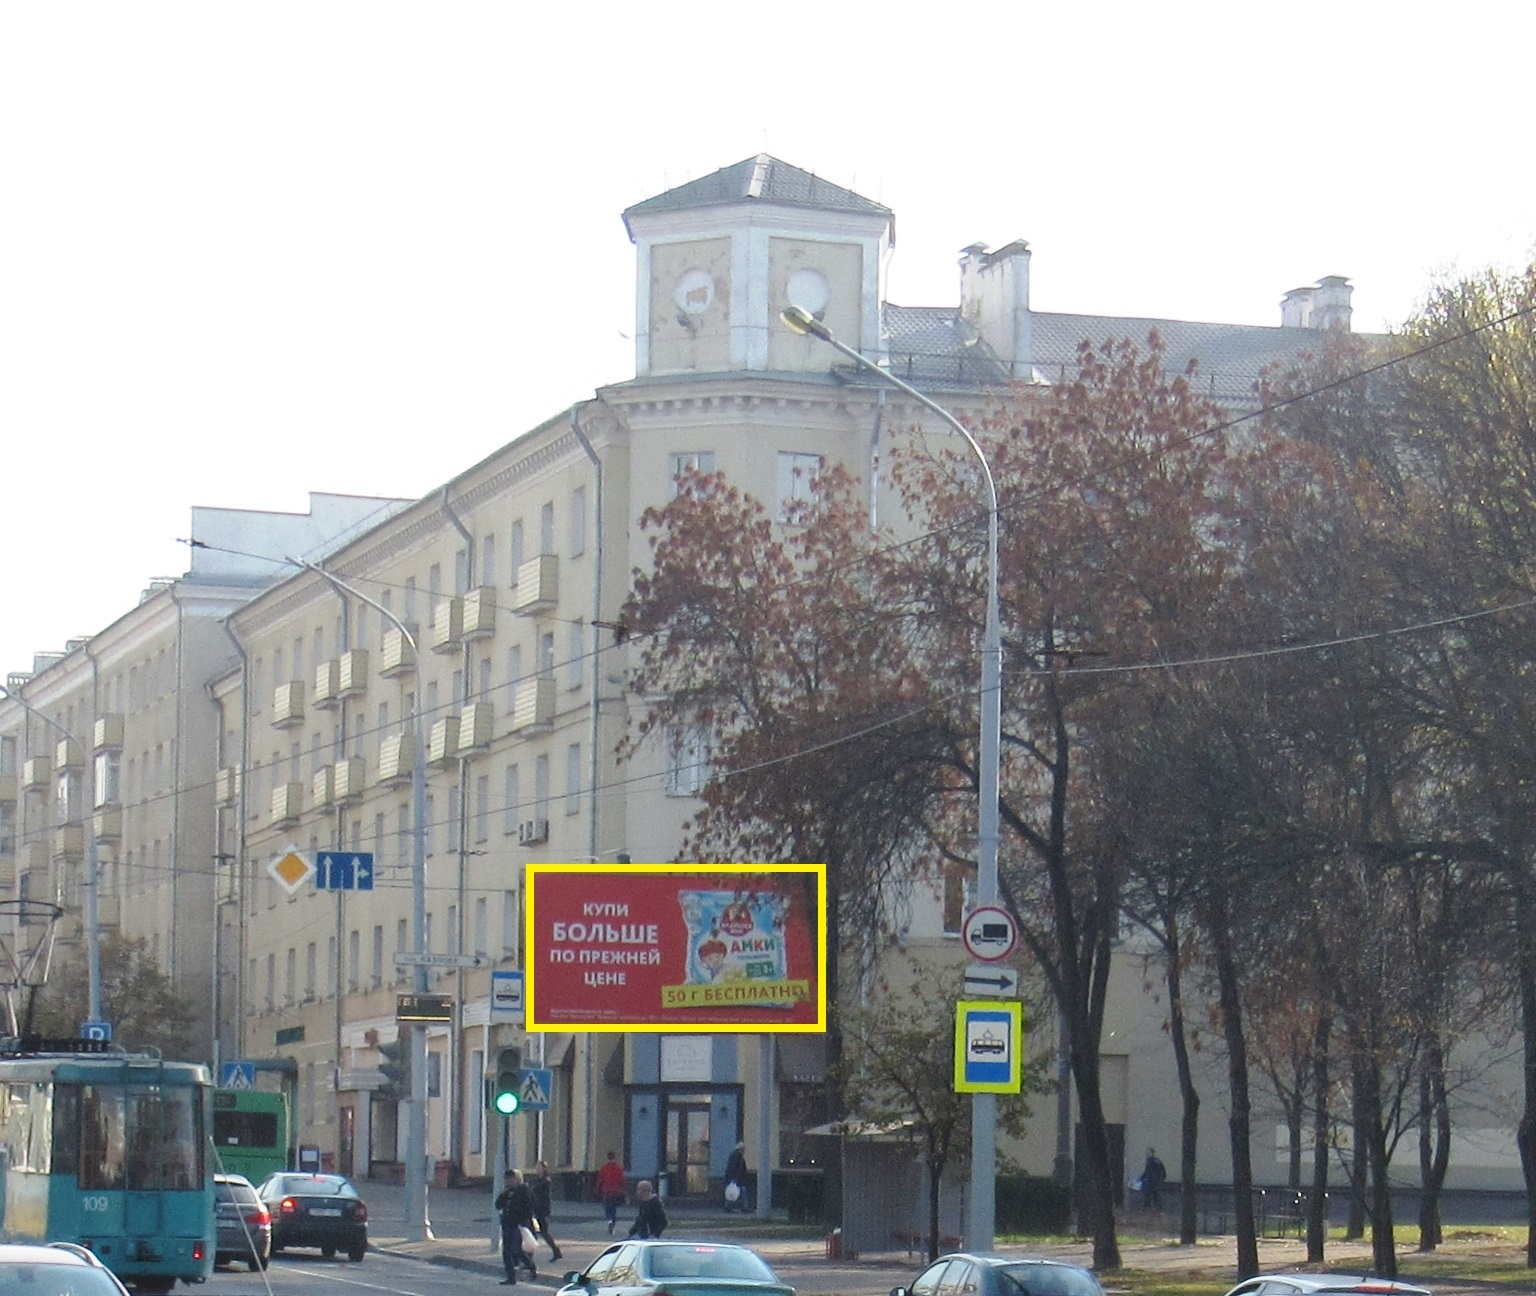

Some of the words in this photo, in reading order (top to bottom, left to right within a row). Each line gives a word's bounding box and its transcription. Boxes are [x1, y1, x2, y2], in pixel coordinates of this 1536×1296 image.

[583, 903, 629, 917] КУПИ
[553, 922, 659, 944] БОЛЬШЕ
[550, 949, 575, 963] ПО
[579, 948, 661, 965] ПРЕЖНЕЙ
[584, 972, 627, 988] ЦЕНЕ
[667, 990, 686, 1003] 50
[704, 985, 804, 1001] БЕСПЛАТНО
[82, 1196, 109, 1211] 109
